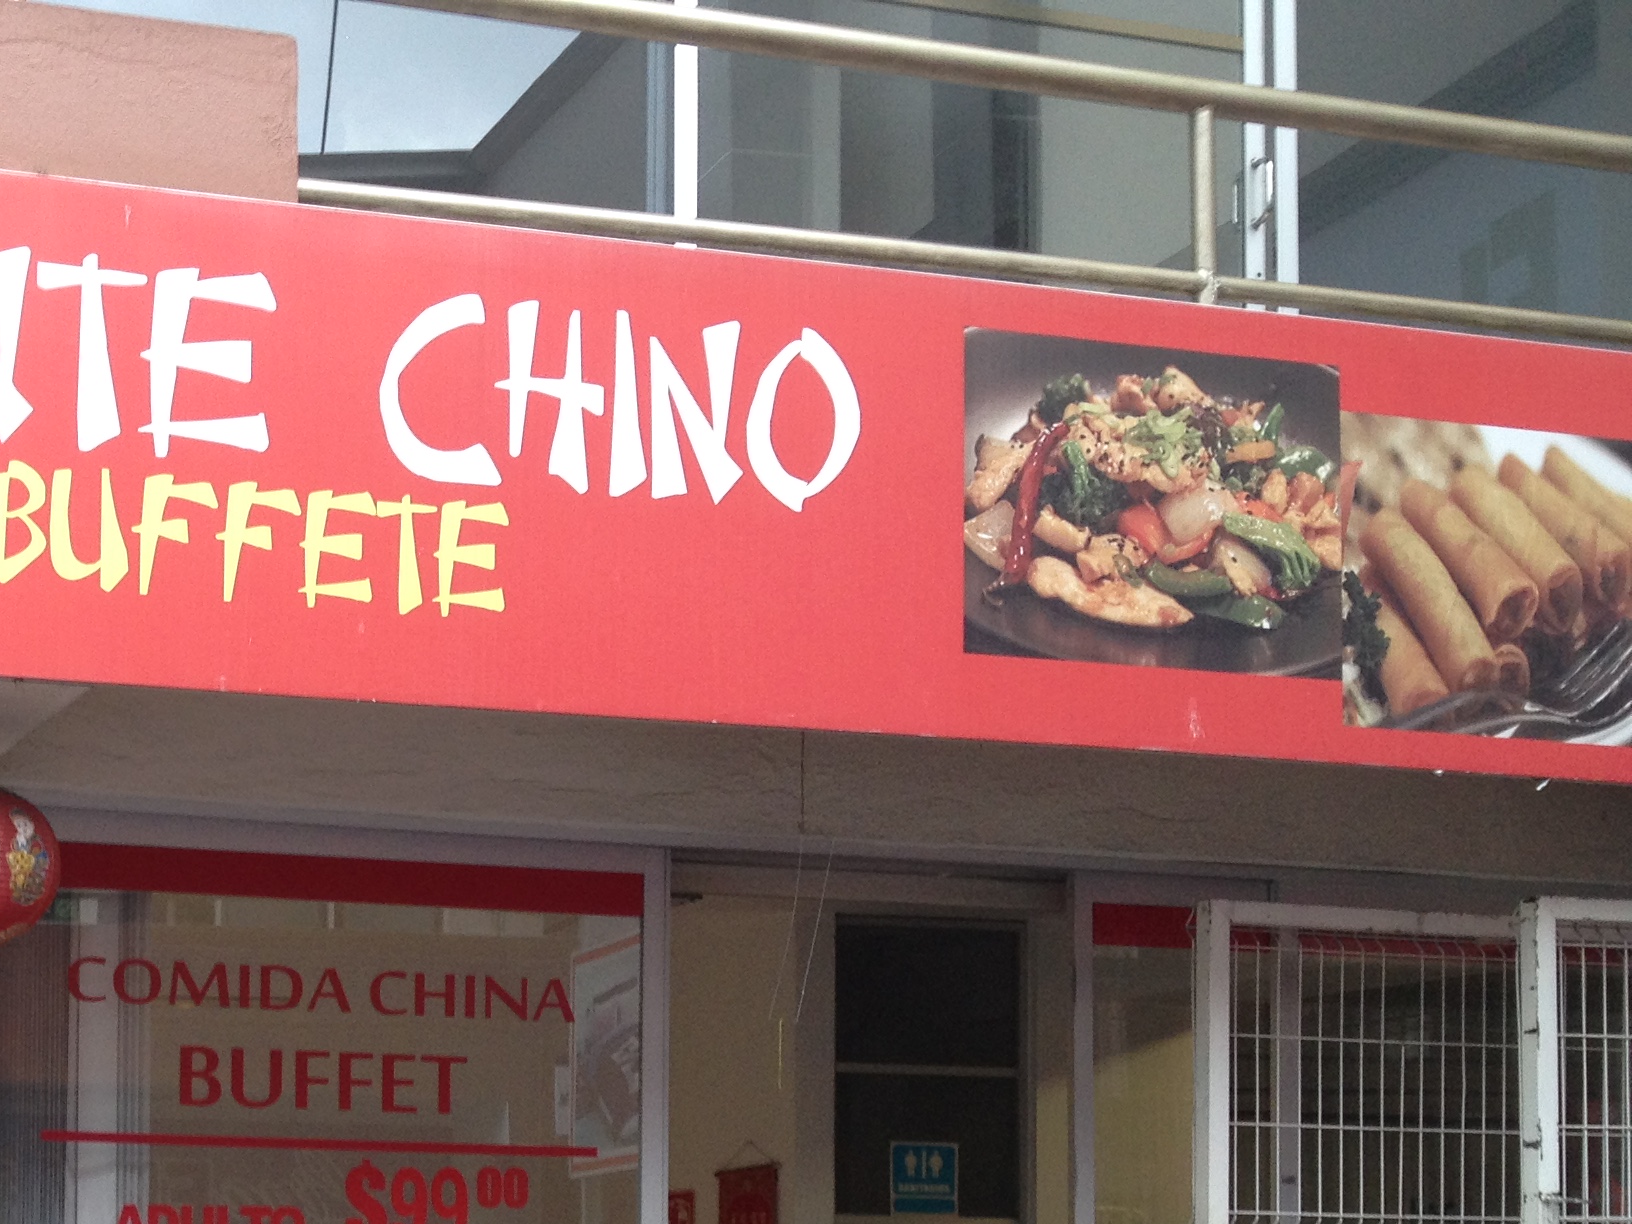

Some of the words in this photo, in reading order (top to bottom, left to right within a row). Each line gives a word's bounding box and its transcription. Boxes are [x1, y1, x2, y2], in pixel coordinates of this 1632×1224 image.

[378, 293, 861, 513] CHINO
[67, 957, 351, 1013] COMIDA
[370, 970, 575, 1022] CHINA
[179, 1045, 467, 1115] BUFFET
